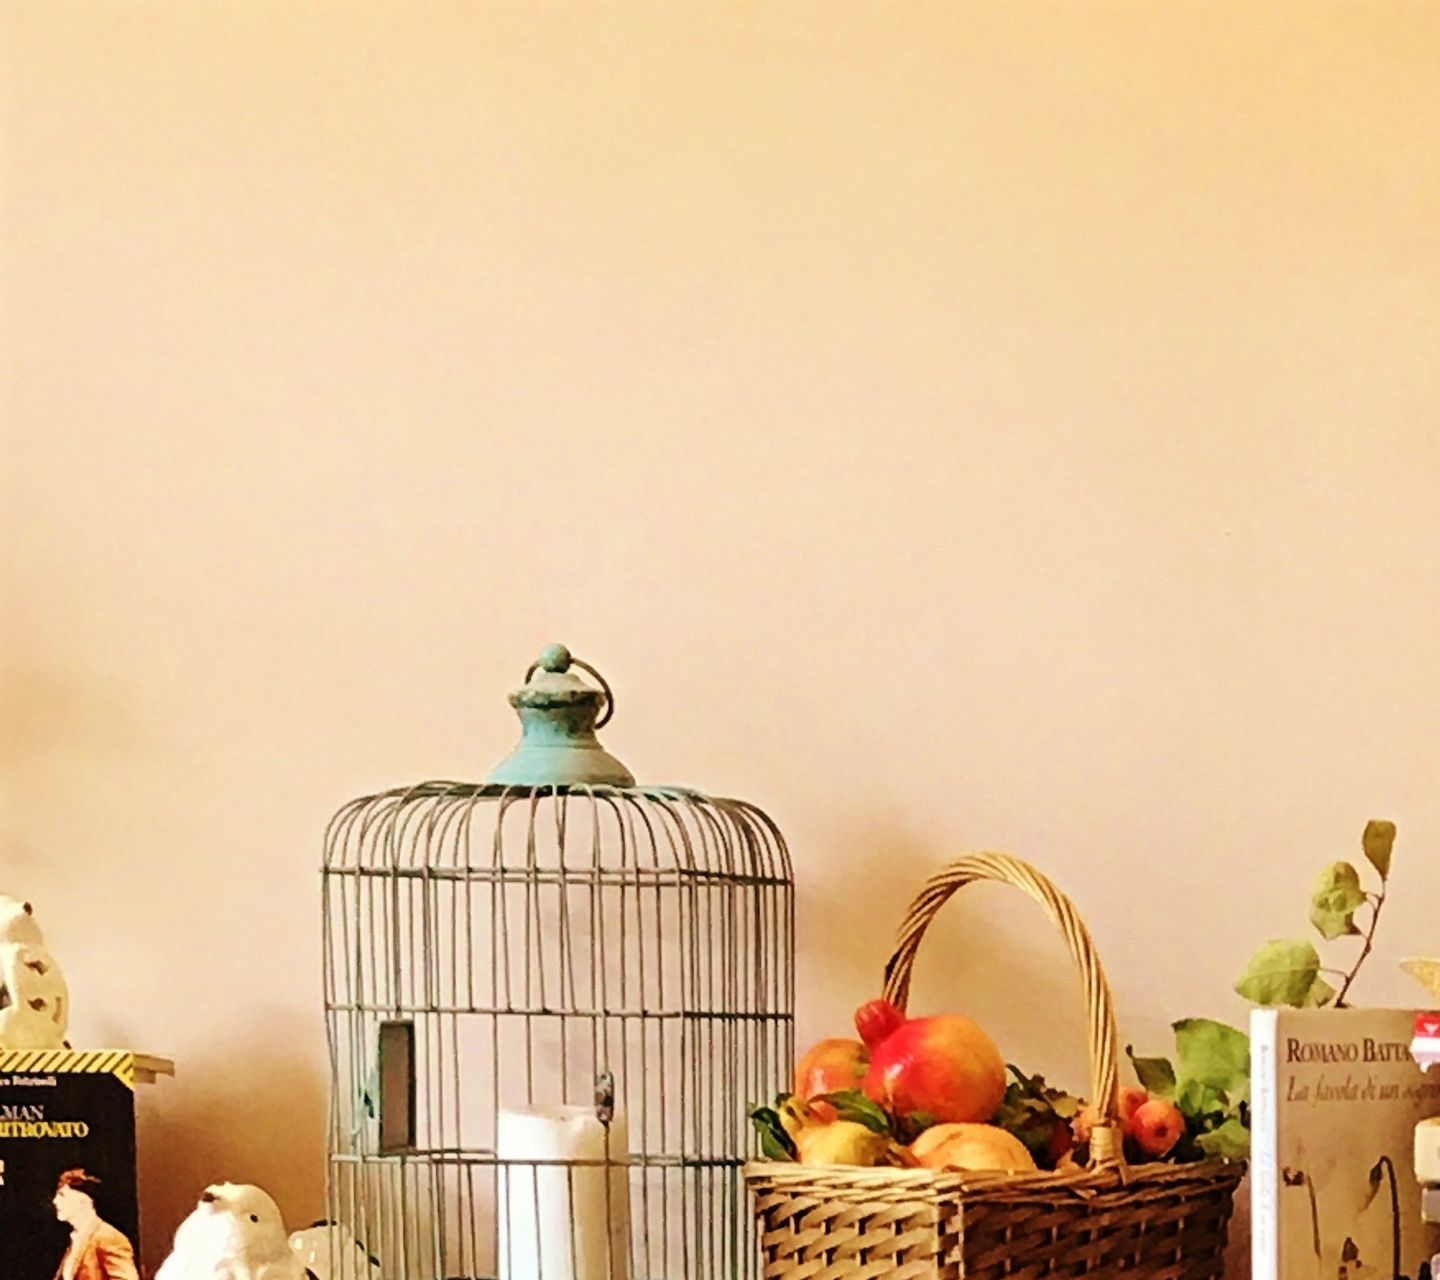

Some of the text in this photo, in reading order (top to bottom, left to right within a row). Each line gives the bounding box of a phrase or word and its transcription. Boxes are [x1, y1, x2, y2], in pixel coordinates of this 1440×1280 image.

[1286, 1038, 1359, 1064] ROMANO
[1287, 1075, 1310, 1102] La
[0, 1104, 44, 1121] MAN
[0, 1120, 90, 1139] ITROVATO
